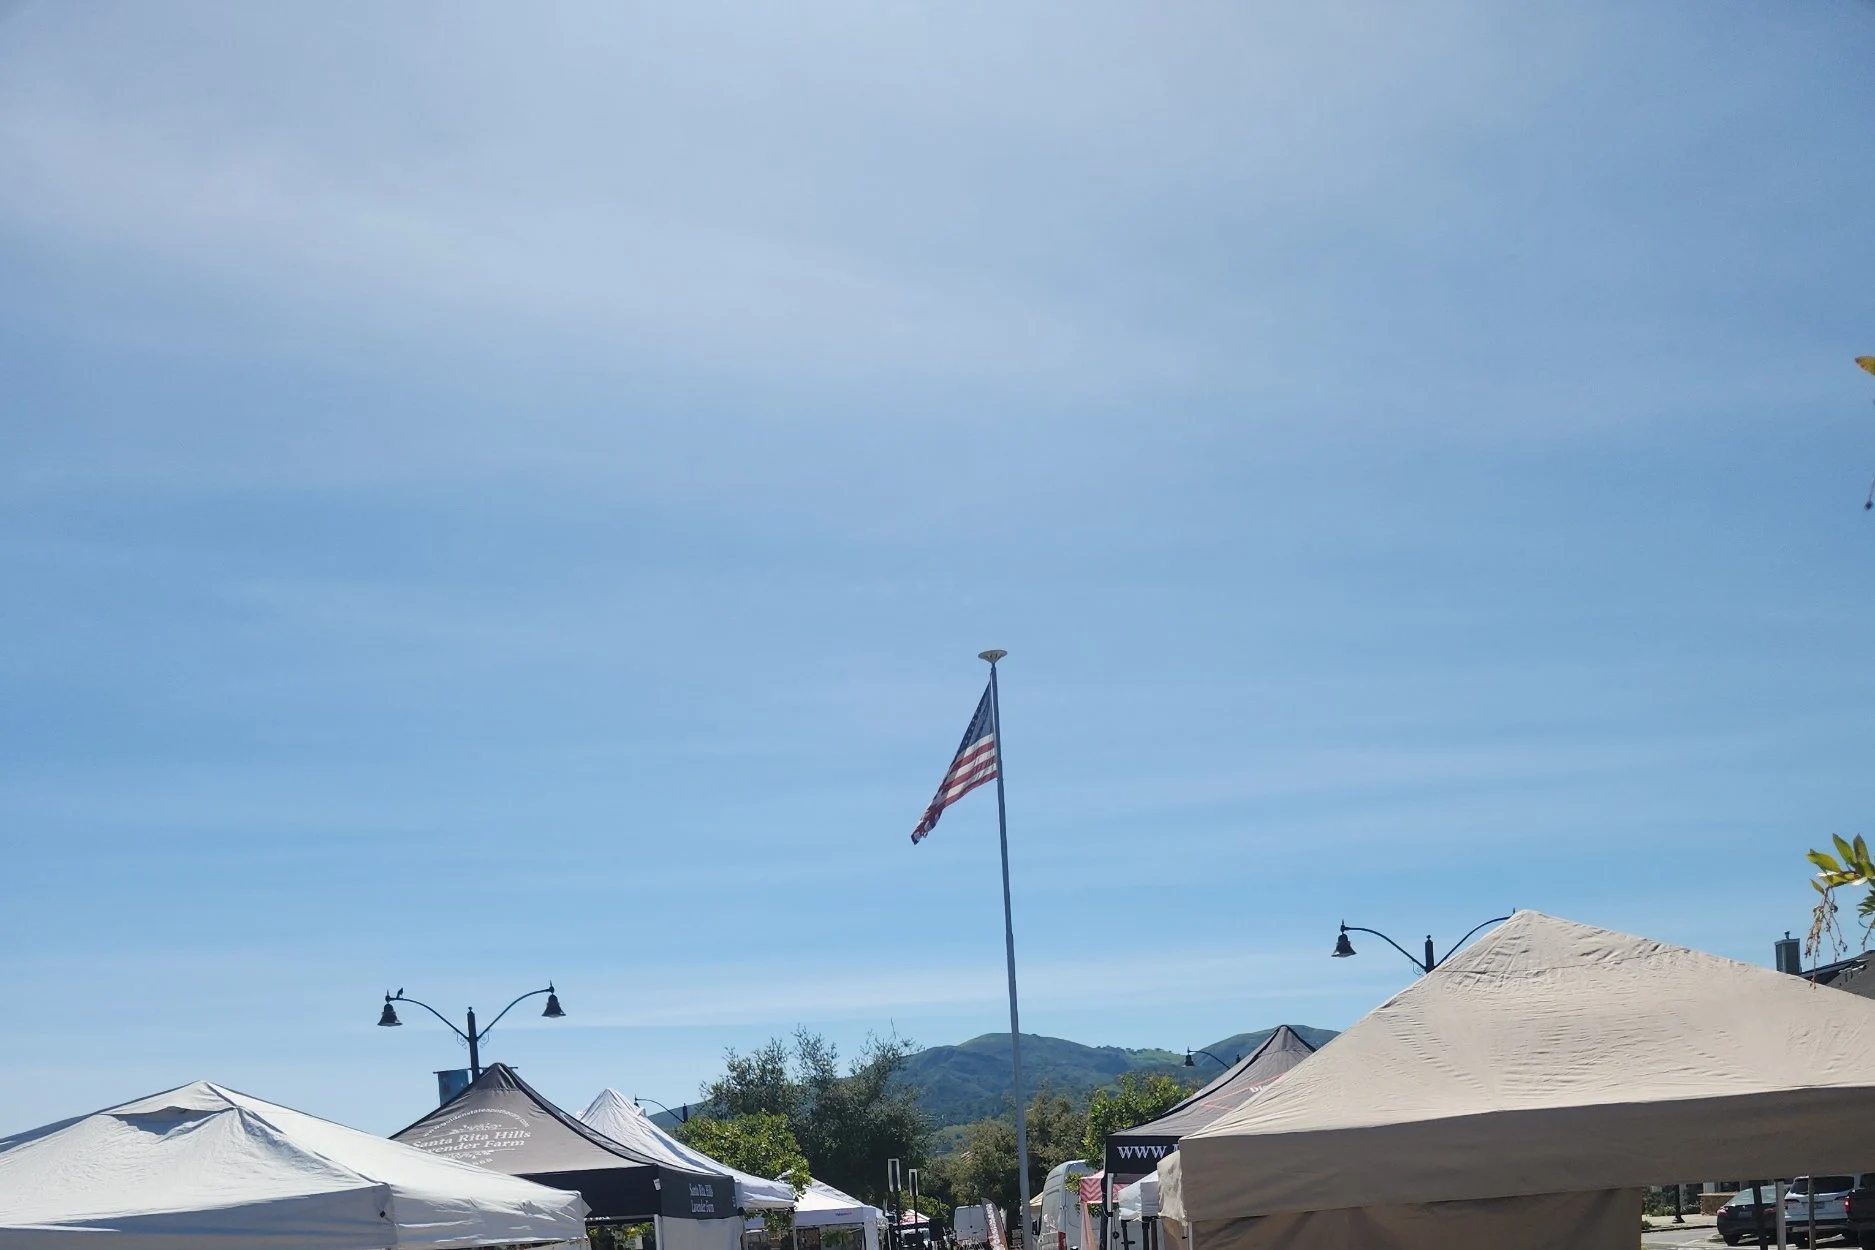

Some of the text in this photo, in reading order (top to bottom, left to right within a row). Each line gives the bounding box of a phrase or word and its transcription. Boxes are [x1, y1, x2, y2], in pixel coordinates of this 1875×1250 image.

[457, 1132, 490, 1143] Rita
[495, 1130, 532, 1140] Hills
[484, 1139, 526, 1148] Farm
